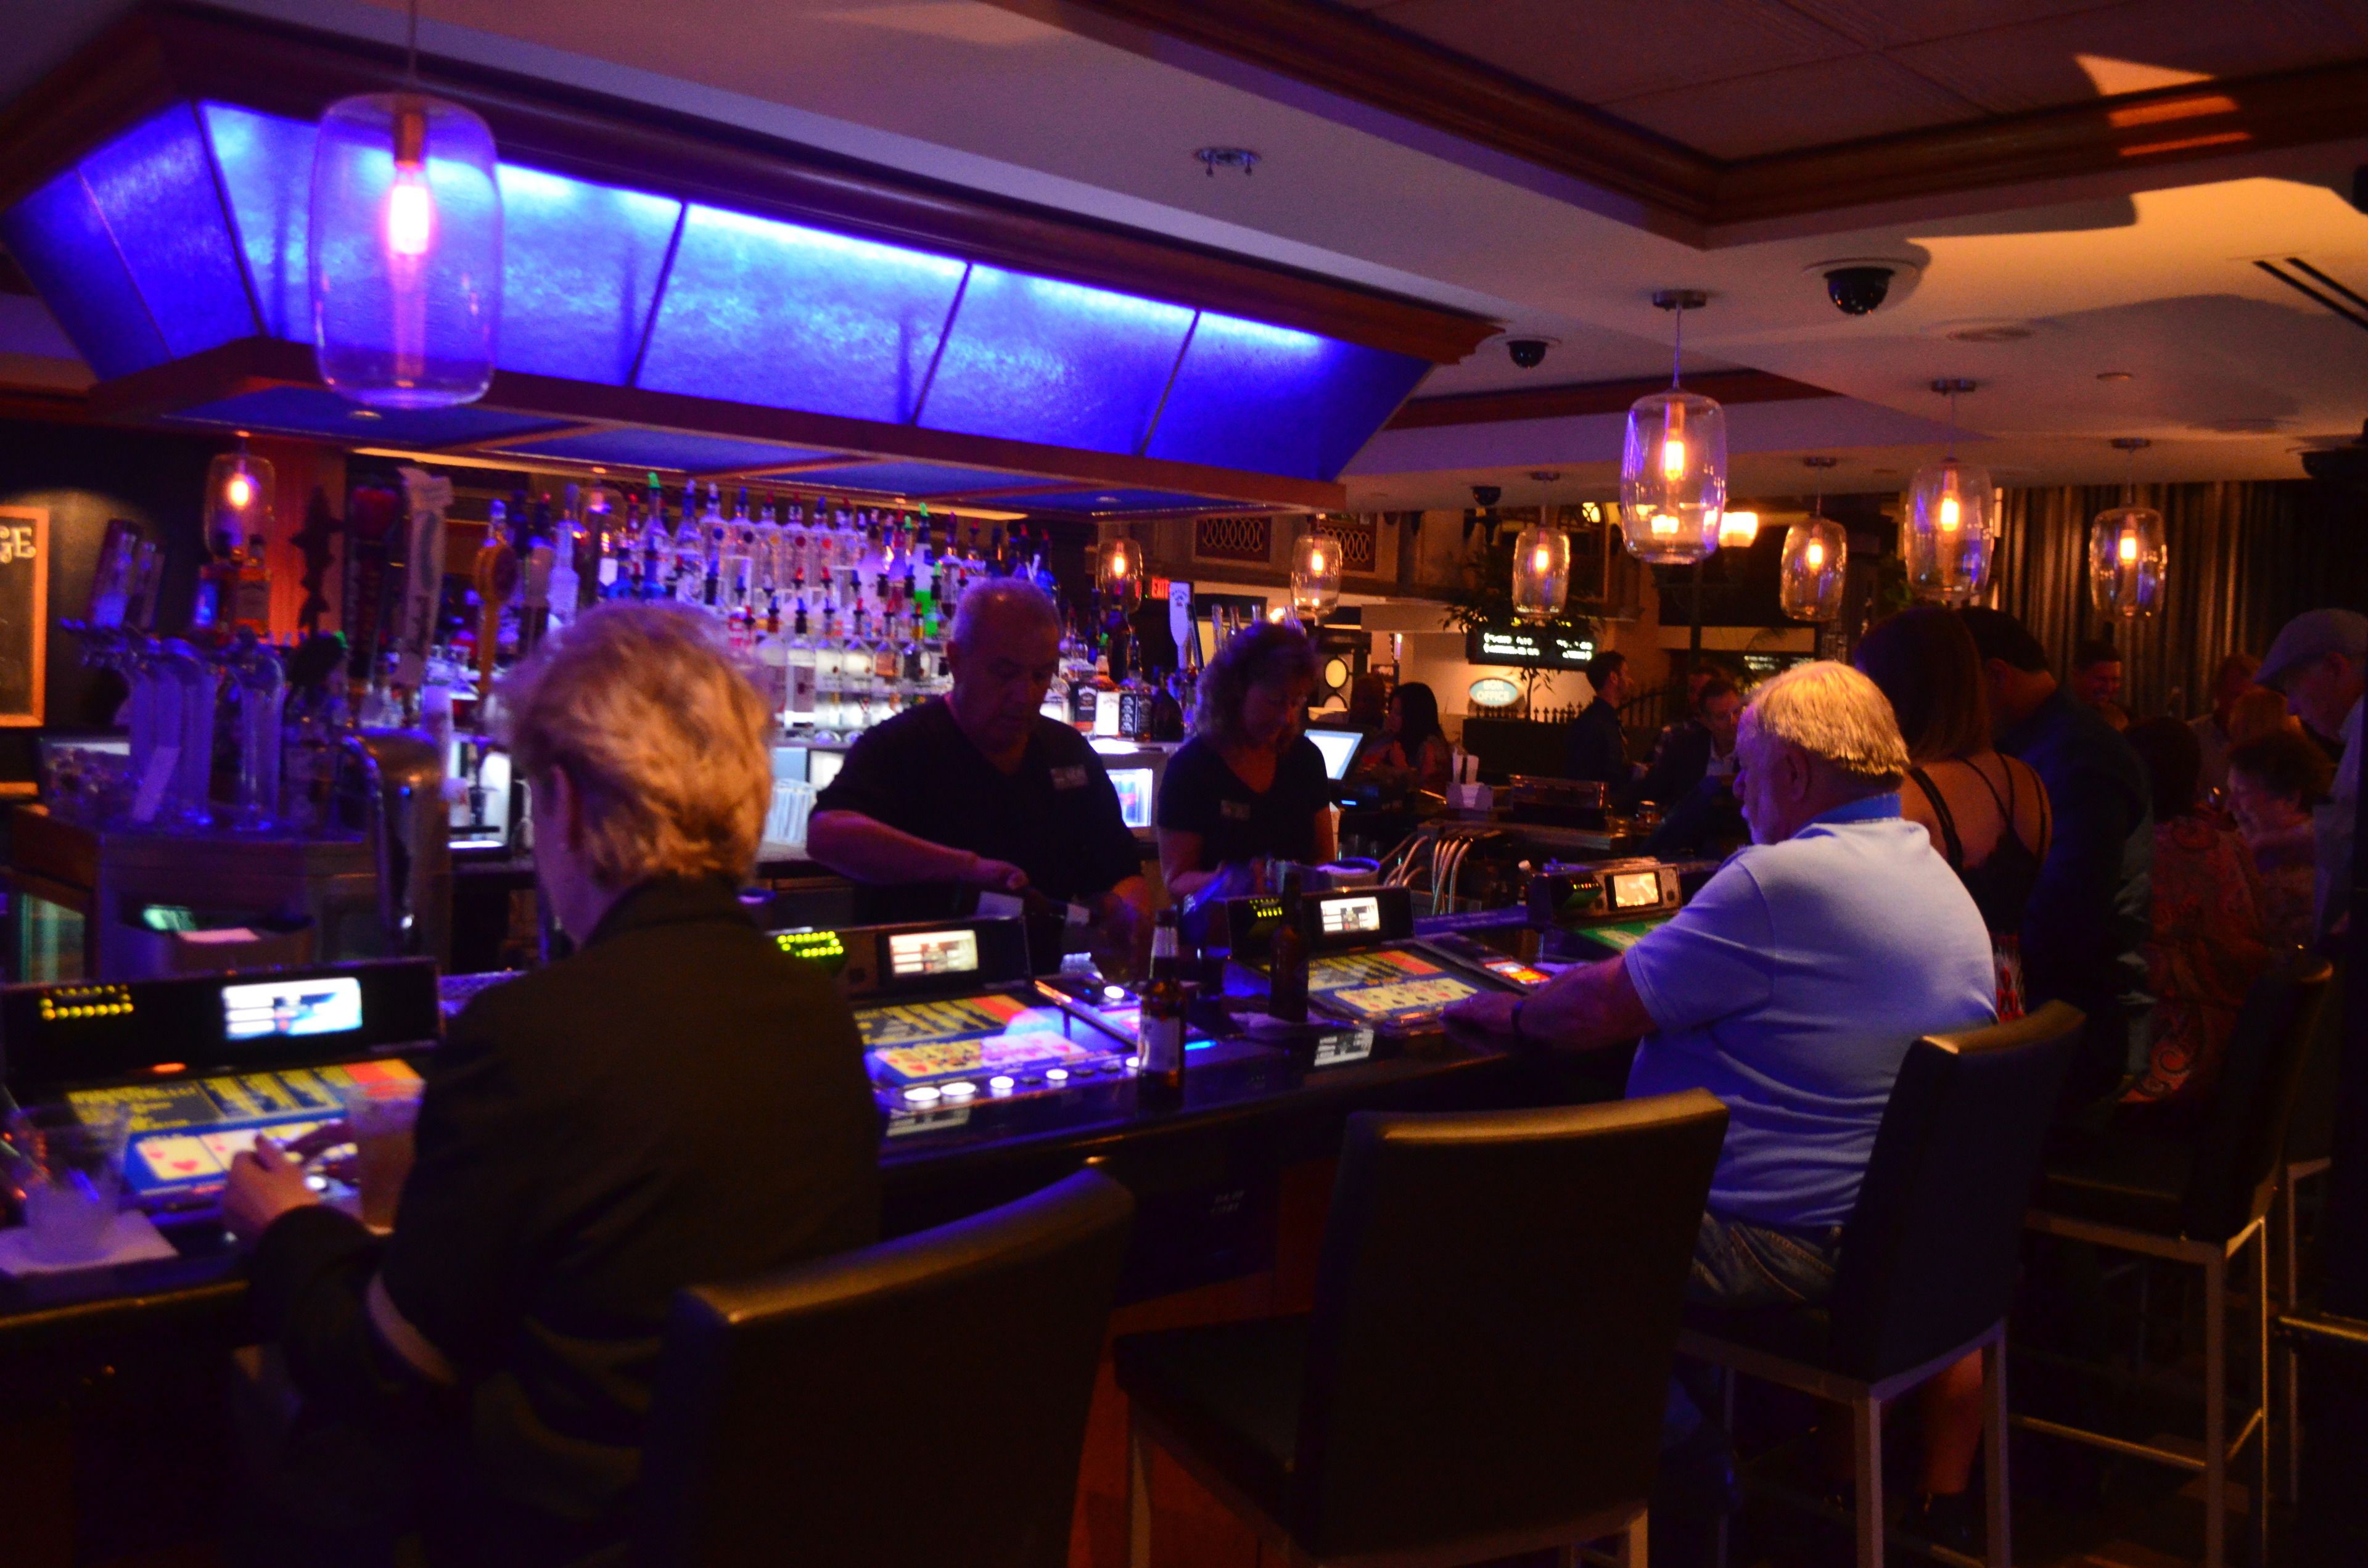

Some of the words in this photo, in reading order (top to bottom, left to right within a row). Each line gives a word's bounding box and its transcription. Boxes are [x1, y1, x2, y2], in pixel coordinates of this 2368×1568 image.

[1151, 577, 1170, 599] EXIT
[1483, 679, 1504, 690] BOX
[1476, 690, 1510, 702] OFFICE
